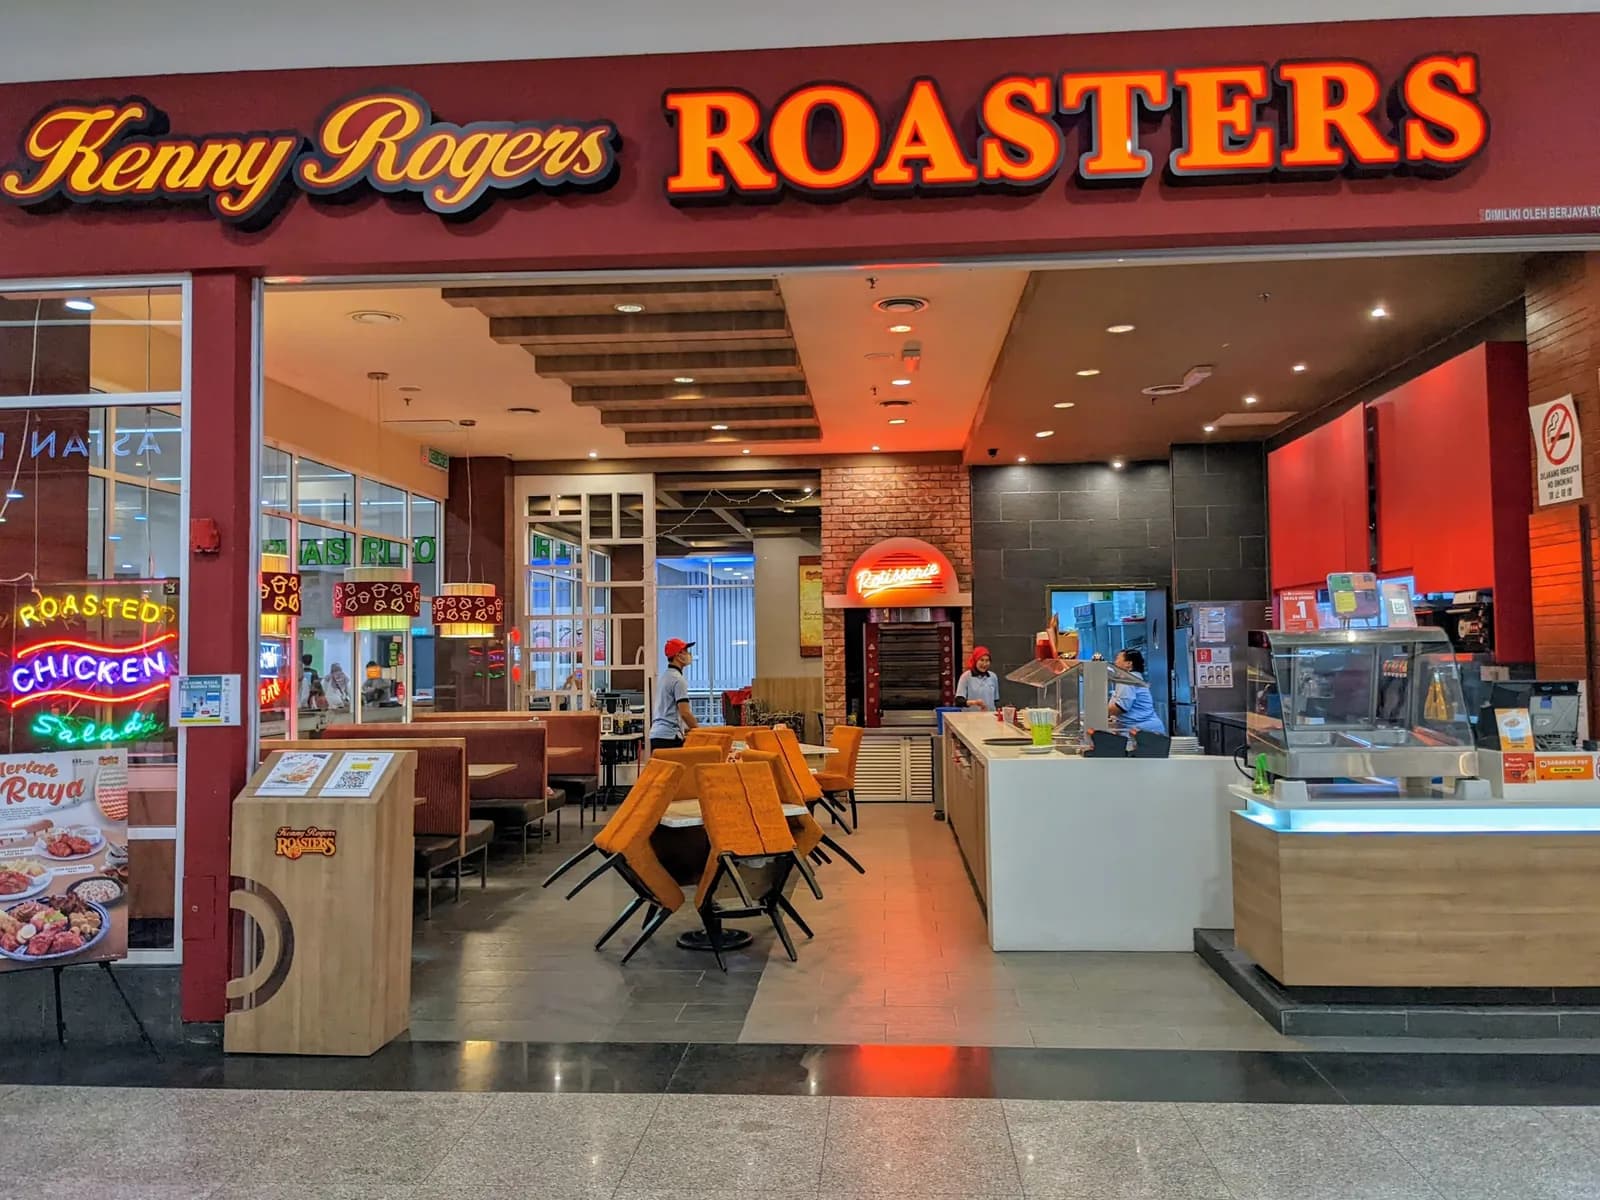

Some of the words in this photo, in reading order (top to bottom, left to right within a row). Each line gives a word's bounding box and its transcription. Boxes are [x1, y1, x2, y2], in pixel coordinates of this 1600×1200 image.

[3, 106, 297, 213] Kenny
[301, 95, 609, 205] Rogers
[664, 55, 1487, 194] ROASTERS
[1484, 207, 1521, 221] DIMILIKI
[1522, 206, 1548, 220] OLEH
[1549, 204, 1589, 219] BERJAYA
[856, 563, 940, 594] Rotisserie
[18, 593, 162, 628] ROASTED
[12, 650, 167, 694] CHICKEN
[0, 776, 85, 806] Raya
[276, 837, 336, 858] ROASTERS
